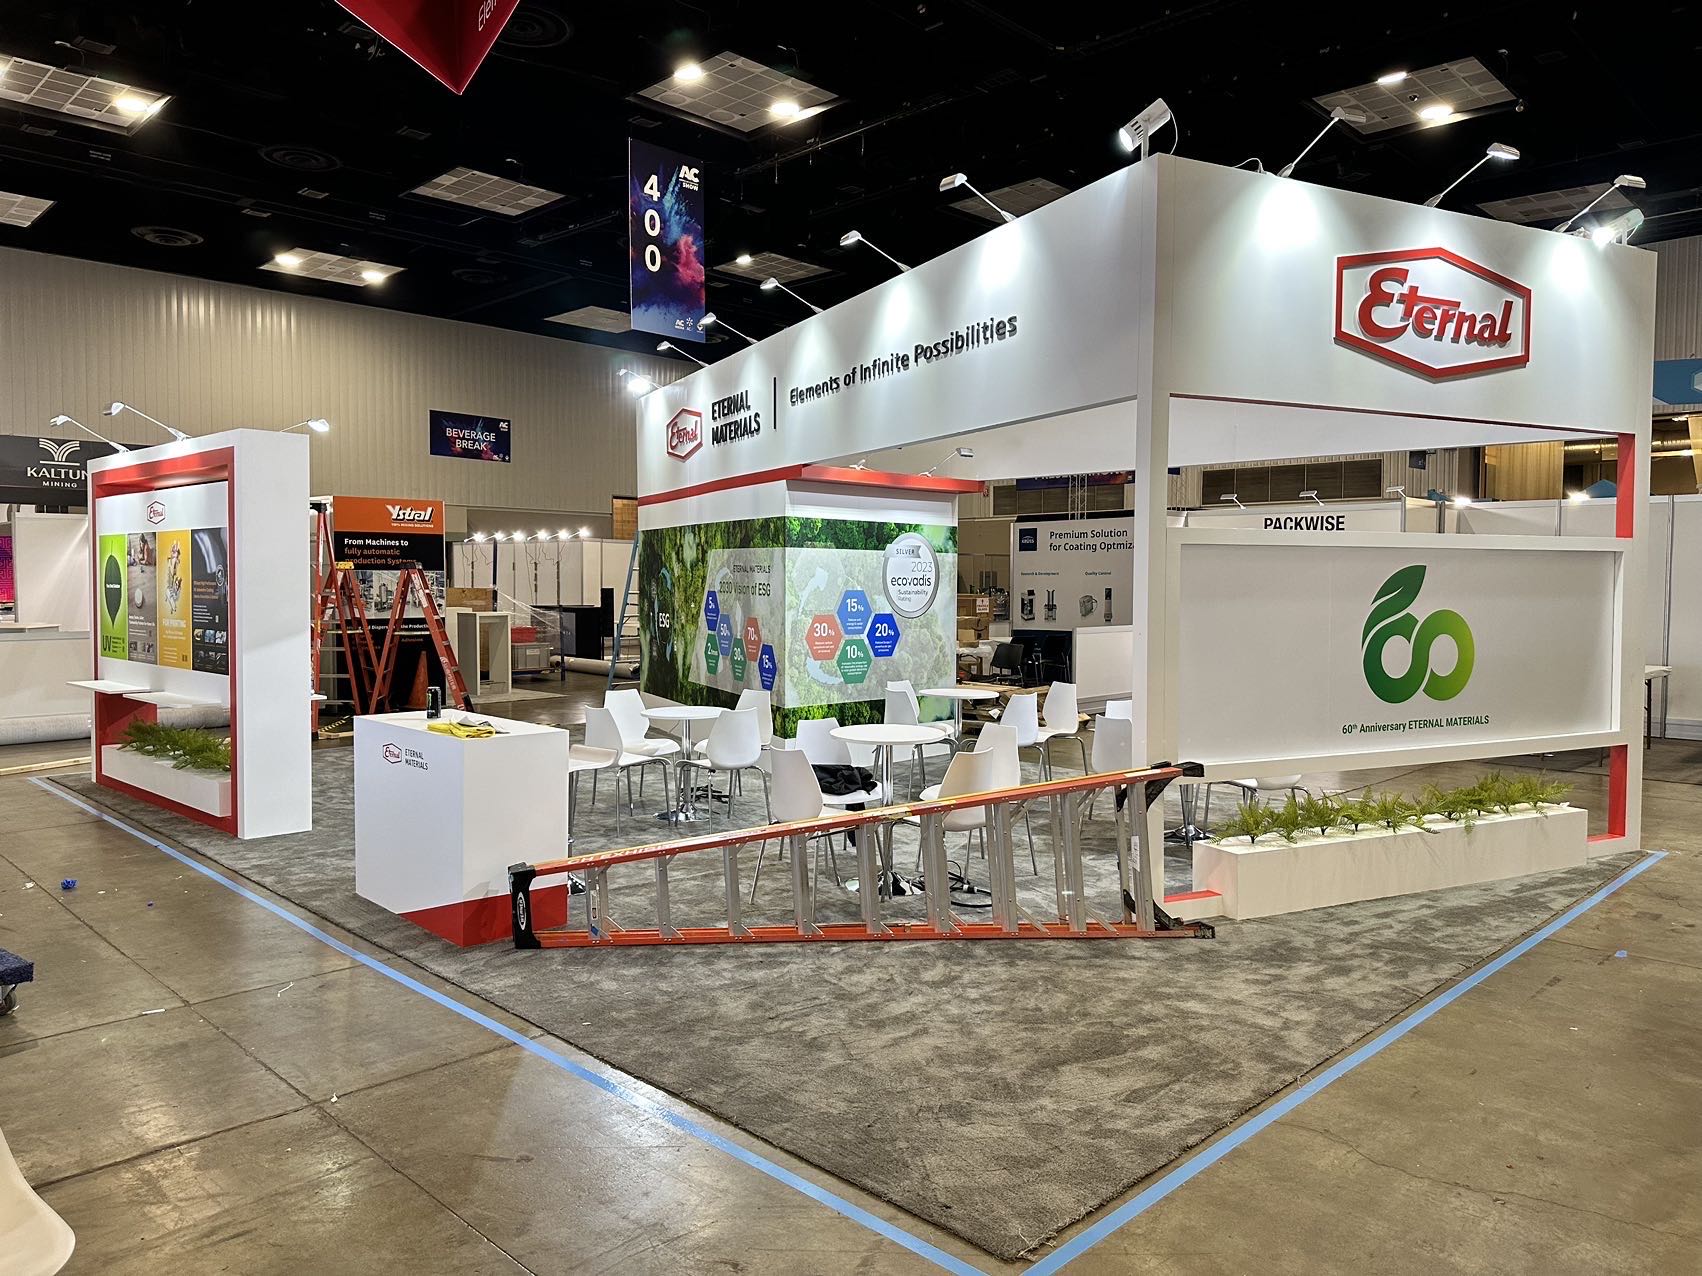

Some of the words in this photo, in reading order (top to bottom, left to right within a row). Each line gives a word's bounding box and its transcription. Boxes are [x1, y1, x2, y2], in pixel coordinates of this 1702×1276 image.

[679, 165, 700, 182] AC
[682, 182, 699, 191] SHOW
[1358, 267, 1514, 344] Eternal
[790, 375, 840, 404] Elements
[843, 367, 858, 387] of
[859, 351, 910, 382] Infinite
[914, 315, 1018, 363] Possibilities
[711, 389, 750, 420] ETERNAL
[446, 428, 496, 442] BEVERAGE
[669, 420, 699, 450] Eternal
[711, 412, 761, 446] MATERIALS
[456, 440, 487, 450] BREAK
[1264, 516, 1345, 530] PACKWISE
[1049, 530, 1088, 540] Premium
[1090, 528, 1128, 538] Solution
[344, 547, 362, 555] fully
[1049, 543, 1062, 552] for
[1064, 542, 1097, 552] Coating
[912, 562, 932, 572] 2023
[890, 574, 932, 586] ecovadis
[720, 581, 732, 594] 2030
[734, 582, 750, 596] Vision
[751, 583, 757, 596] of
[758, 583, 770, 596] ESG
[846, 599, 864, 612] 15%
[659, 612, 670, 628] ESG
[814, 623, 835, 636] 30%
[875, 623, 894, 636] 20%
[846, 645, 864, 658] 10%
[1342, 724, 1358, 734] 60th
[1360, 722, 1407, 733] Anniversary
[1408, 718, 1444, 730] ETERNAL
[1446, 715, 1490, 727] MATERIALS
[405, 748, 424, 760] ETERNAL
[405, 759, 428, 770] MATERIALS
